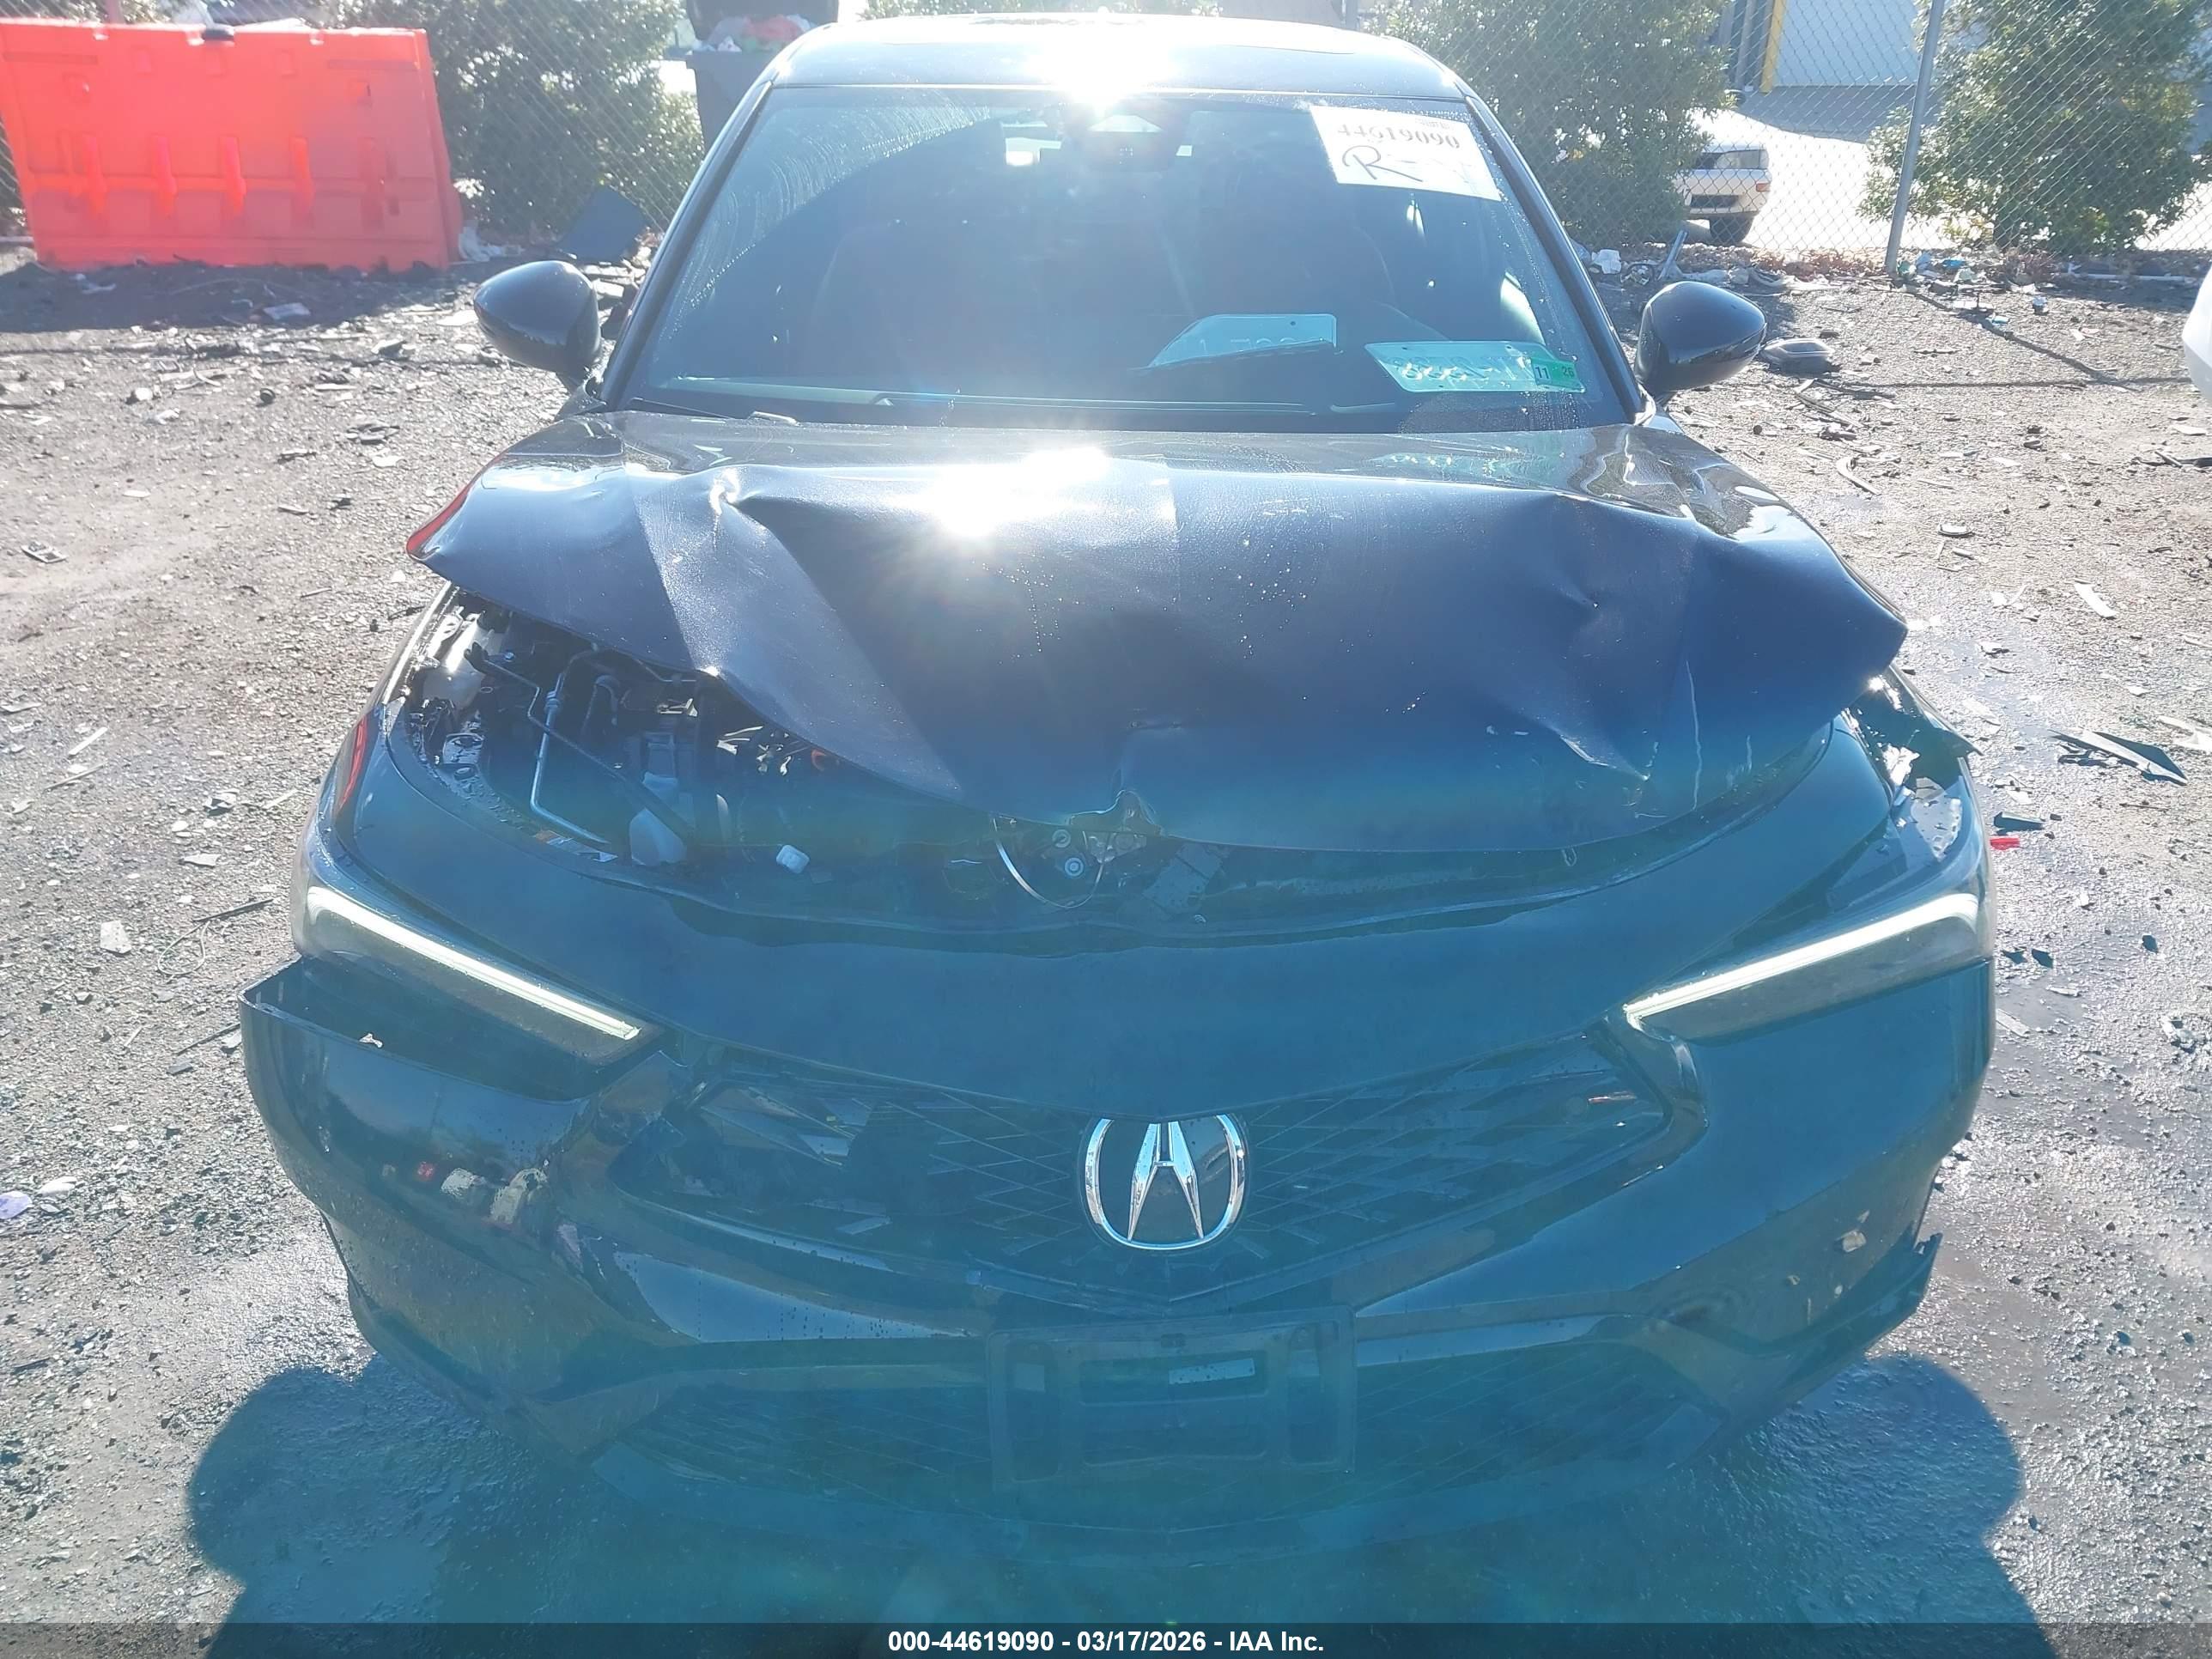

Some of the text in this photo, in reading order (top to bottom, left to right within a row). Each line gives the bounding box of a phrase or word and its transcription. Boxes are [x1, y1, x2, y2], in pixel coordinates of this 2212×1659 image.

[1337, 123, 1461, 149] 44619090
[1534, 365, 1551, 380] 11
[1561, 364, 1575, 378] 26
